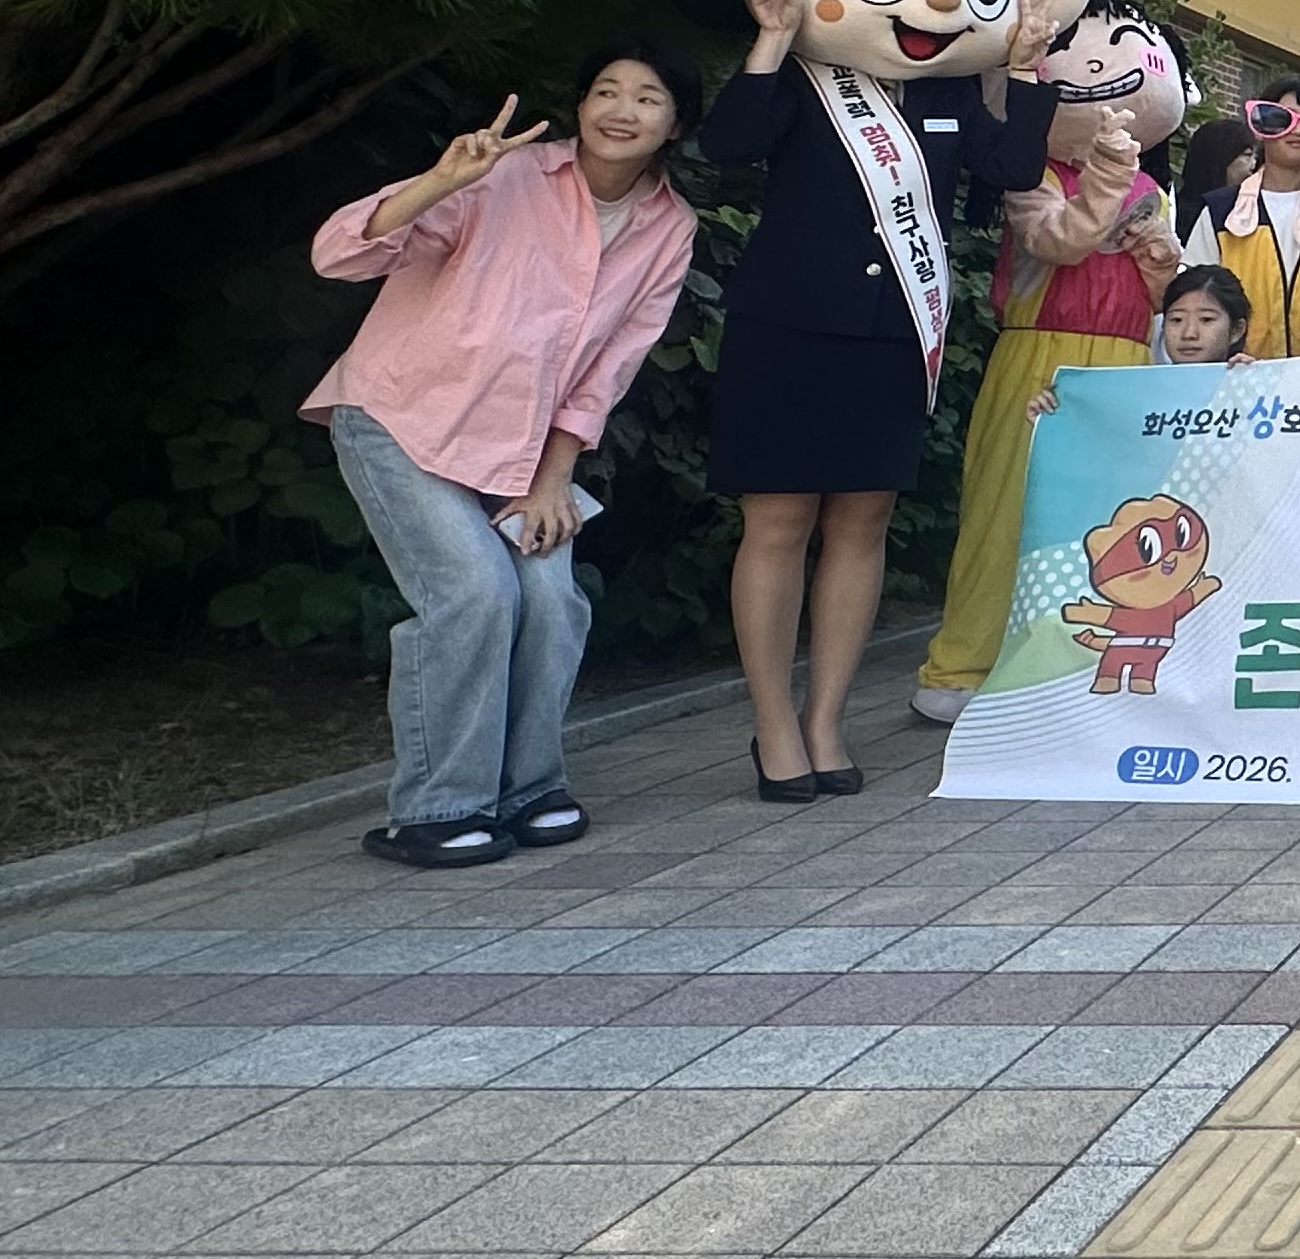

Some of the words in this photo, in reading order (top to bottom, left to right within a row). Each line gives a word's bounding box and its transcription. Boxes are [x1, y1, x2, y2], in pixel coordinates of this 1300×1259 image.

[891, 192, 936, 284] 친구사랑
[1142, 407, 1240, 440] 화성오산
[1131, 749, 1187, 782] 일시
